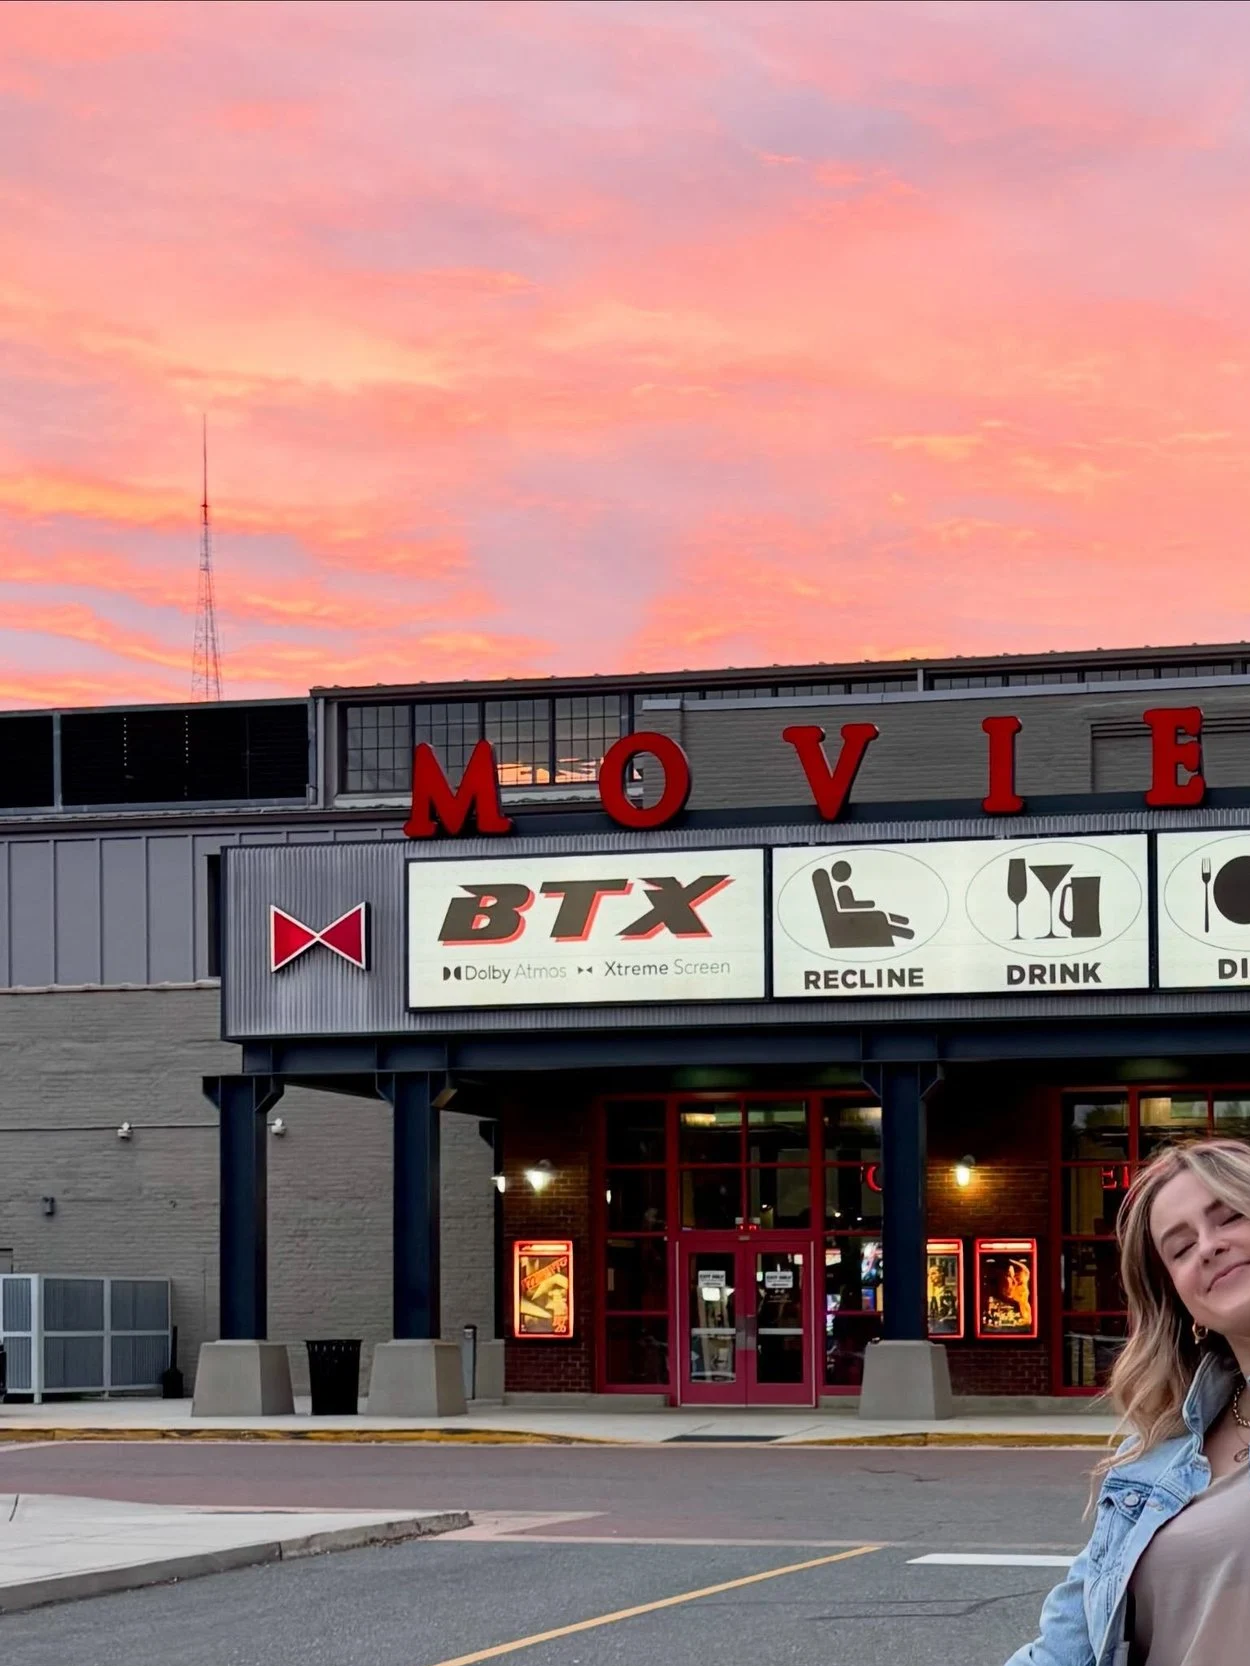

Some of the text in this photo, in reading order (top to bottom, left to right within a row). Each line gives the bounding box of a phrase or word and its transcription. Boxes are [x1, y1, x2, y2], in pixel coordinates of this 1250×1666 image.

[437, 875, 736, 946] BTX
[465, 963, 567, 983] Dolby Atmos
[604, 958, 731, 976] Xtreme Screen
[1007, 962, 1101, 985] DRINK
[804, 968, 925, 990] RECLINE
